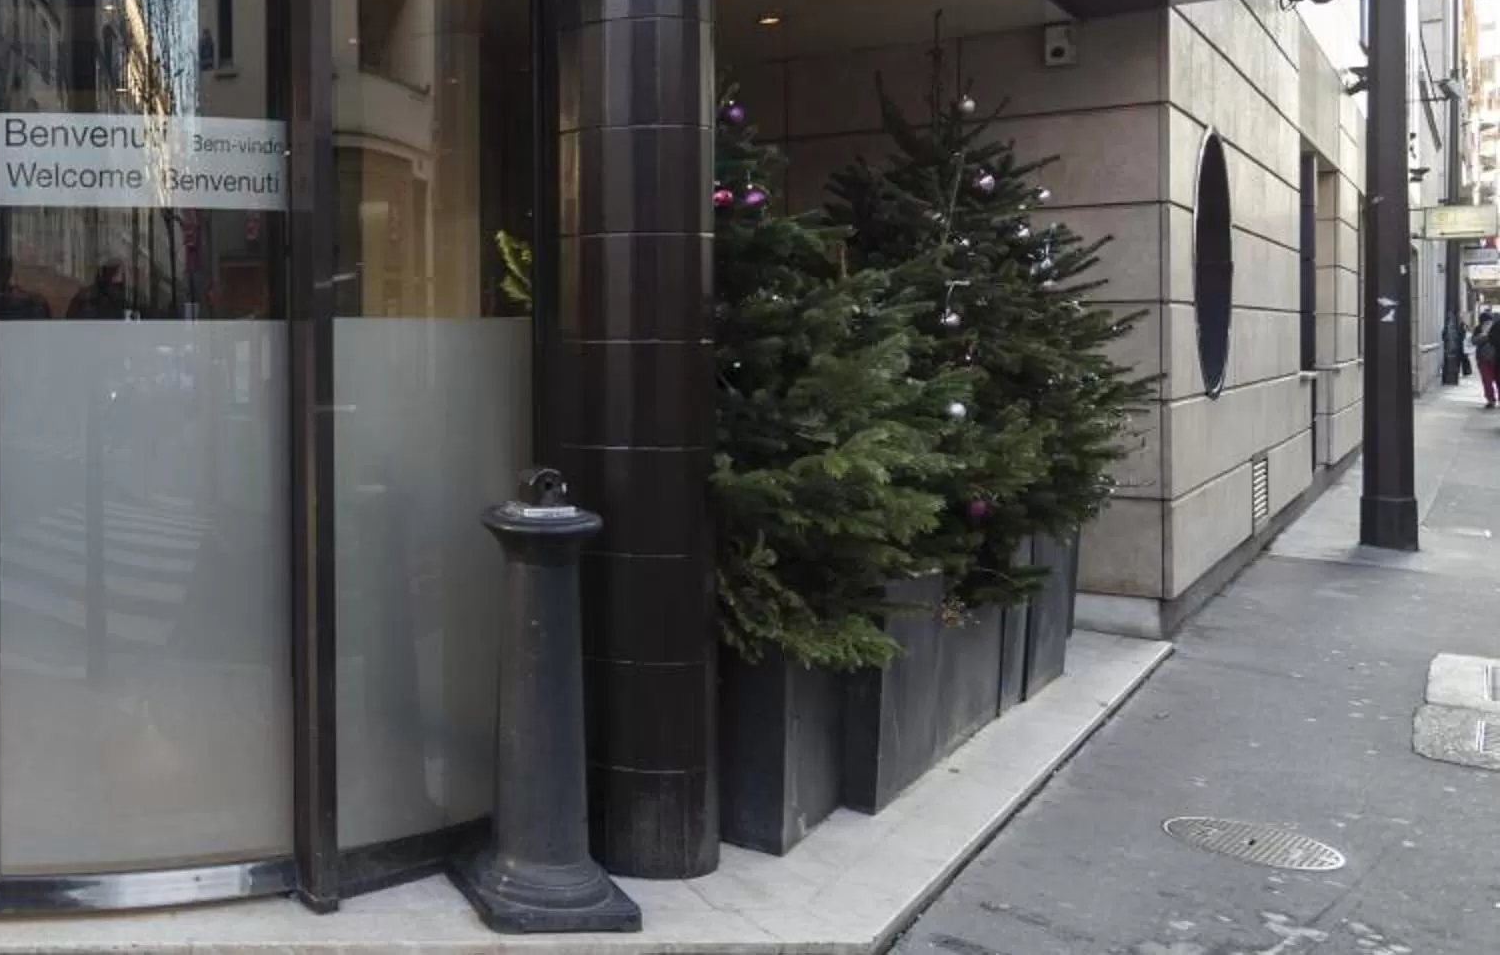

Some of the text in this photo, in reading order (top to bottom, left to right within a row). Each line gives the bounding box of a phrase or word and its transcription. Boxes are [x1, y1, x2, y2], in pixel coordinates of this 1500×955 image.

[193, 134, 285, 155] Bem-vindo
[6, 162, 142, 189] Welcome
[164, 168, 280, 194] Benvenuti
